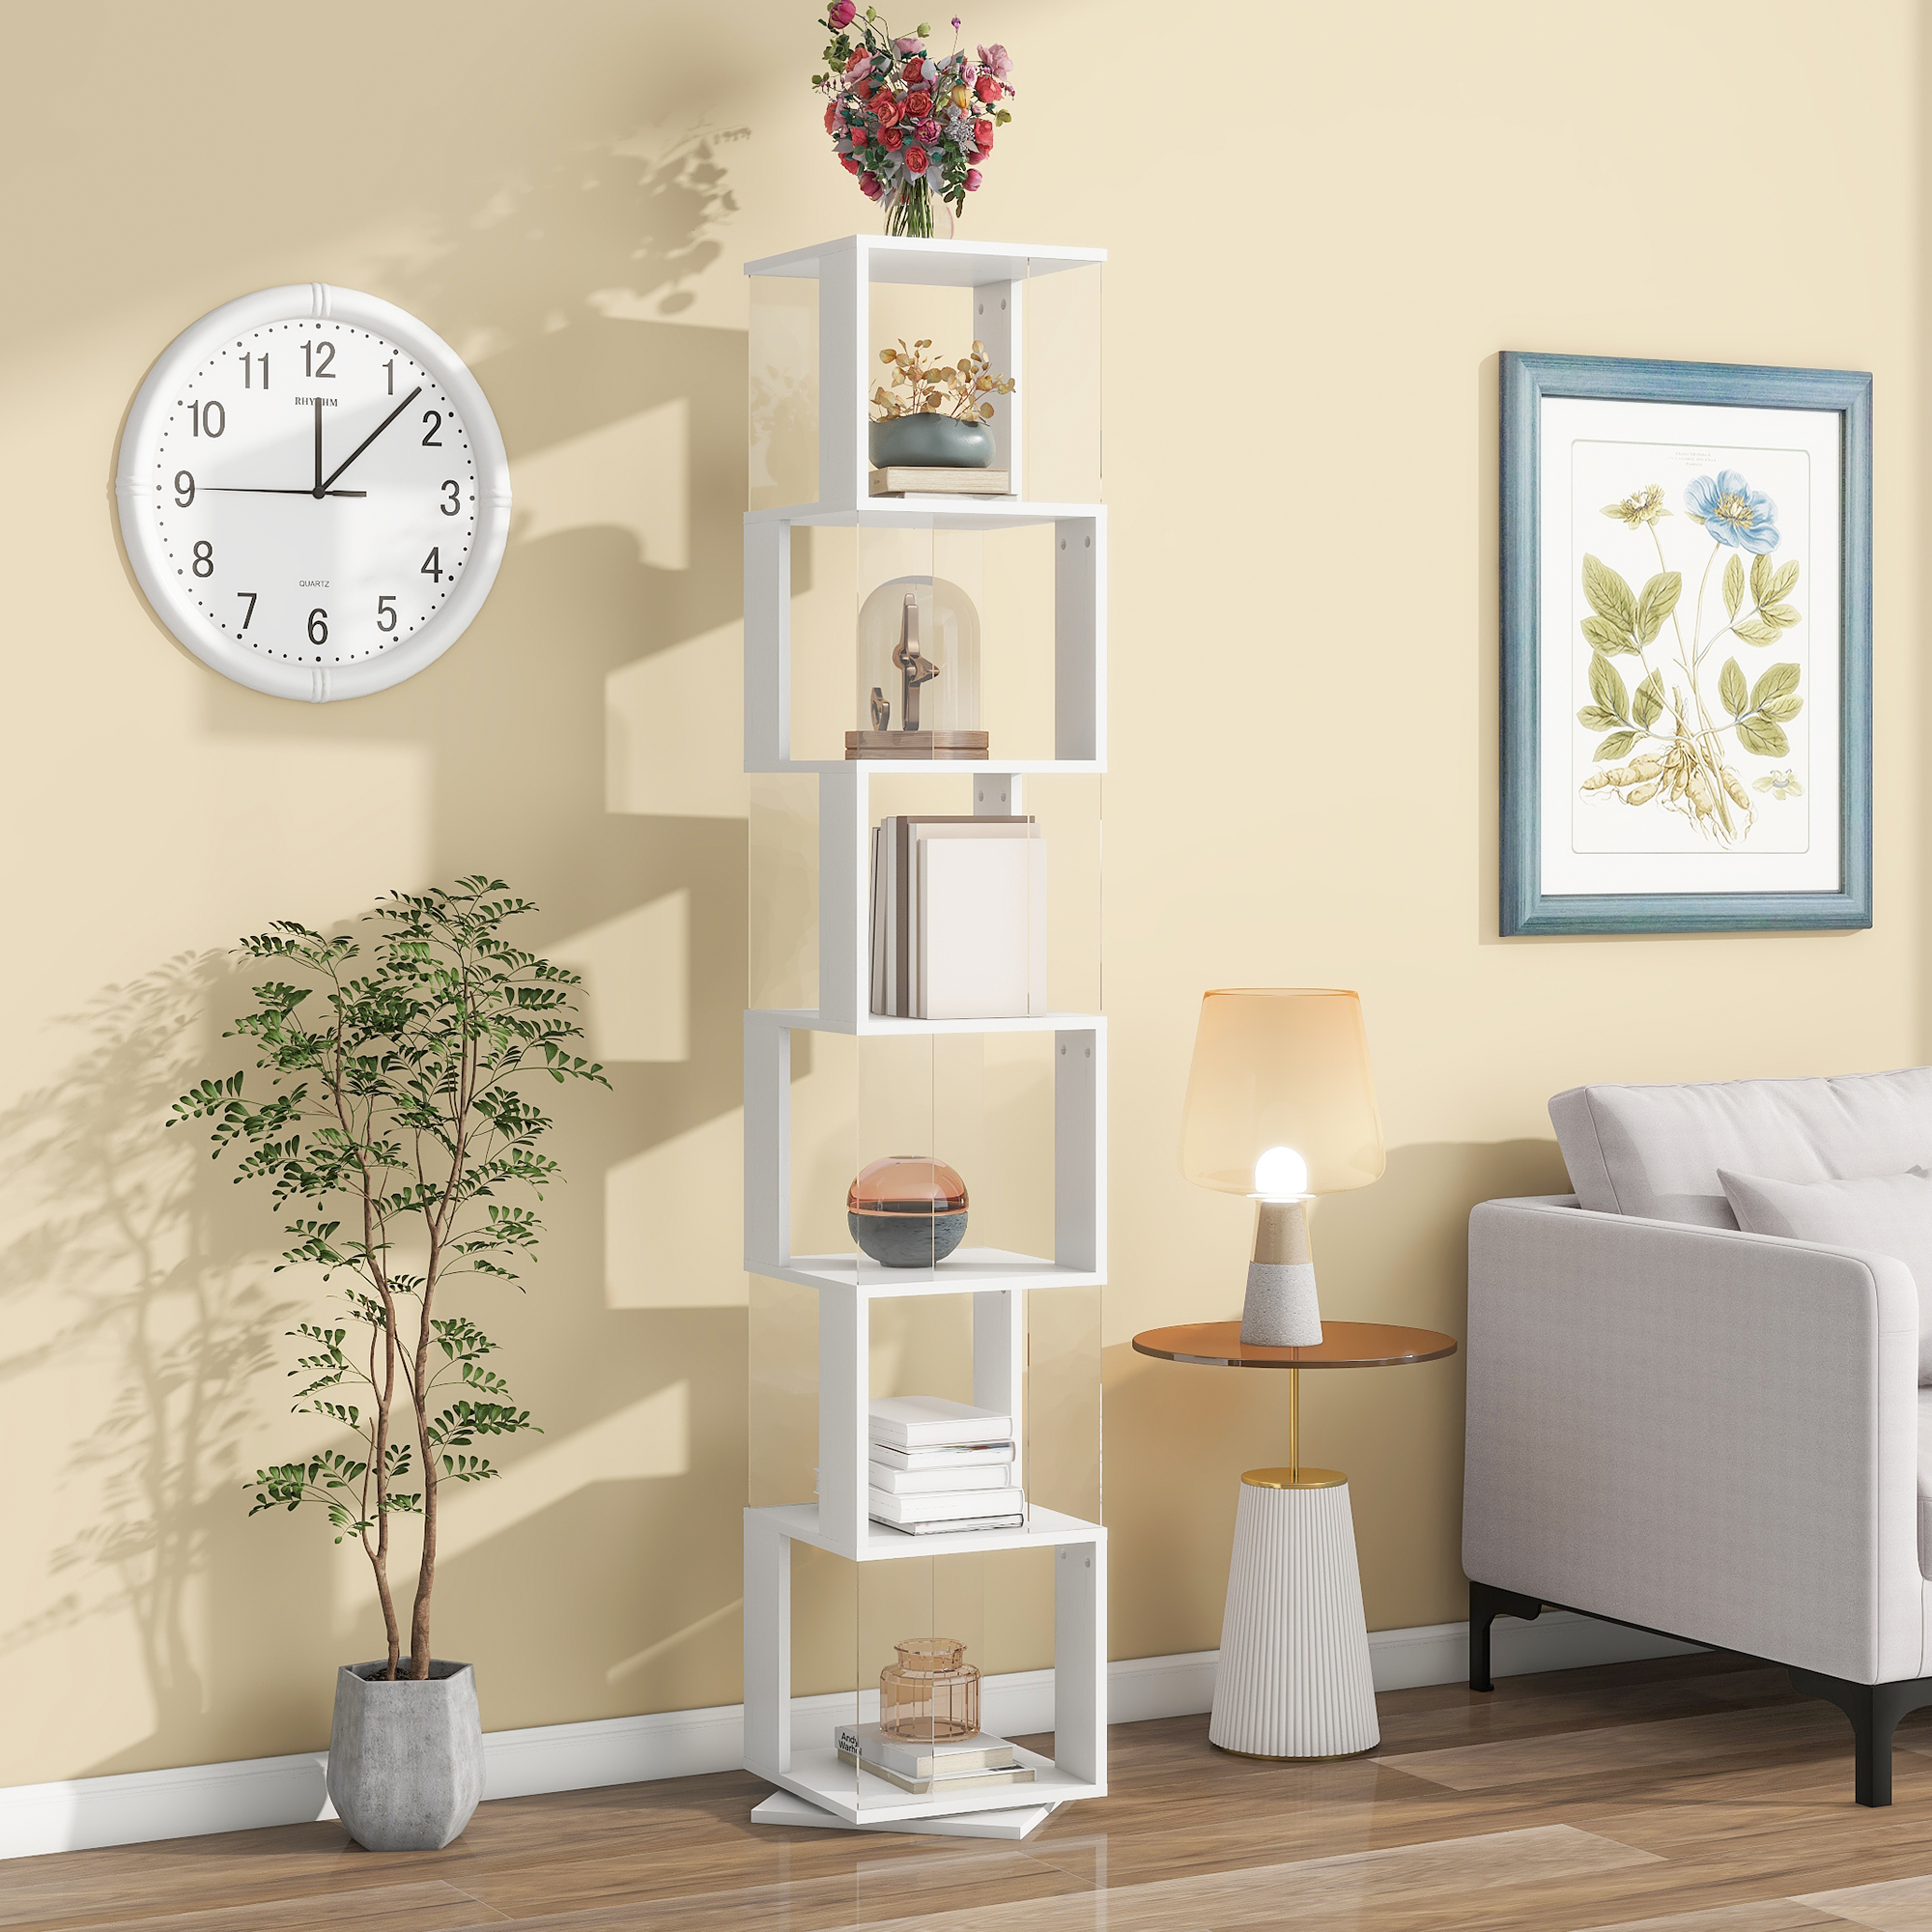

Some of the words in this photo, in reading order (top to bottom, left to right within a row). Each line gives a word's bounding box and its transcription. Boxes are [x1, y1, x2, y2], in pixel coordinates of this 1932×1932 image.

[239, 352, 270, 390] 11
[299, 340, 336, 379] 12
[382, 358, 394, 396] 1
[186, 399, 226, 439] 10
[295, 396, 338, 407] RHYHM
[421, 410, 443, 447] 2
[174, 469, 196, 508] 9
[440, 479, 461, 517] 3
[192, 540, 214, 579] 8
[420, 546, 444, 583] 4
[298, 580, 330, 588] QUARTZ
[237, 592, 258, 630] 7
[307, 608, 328, 646] 6
[377, 595, 397, 633] 5
[841, 1732, 859, 1747] Andy
